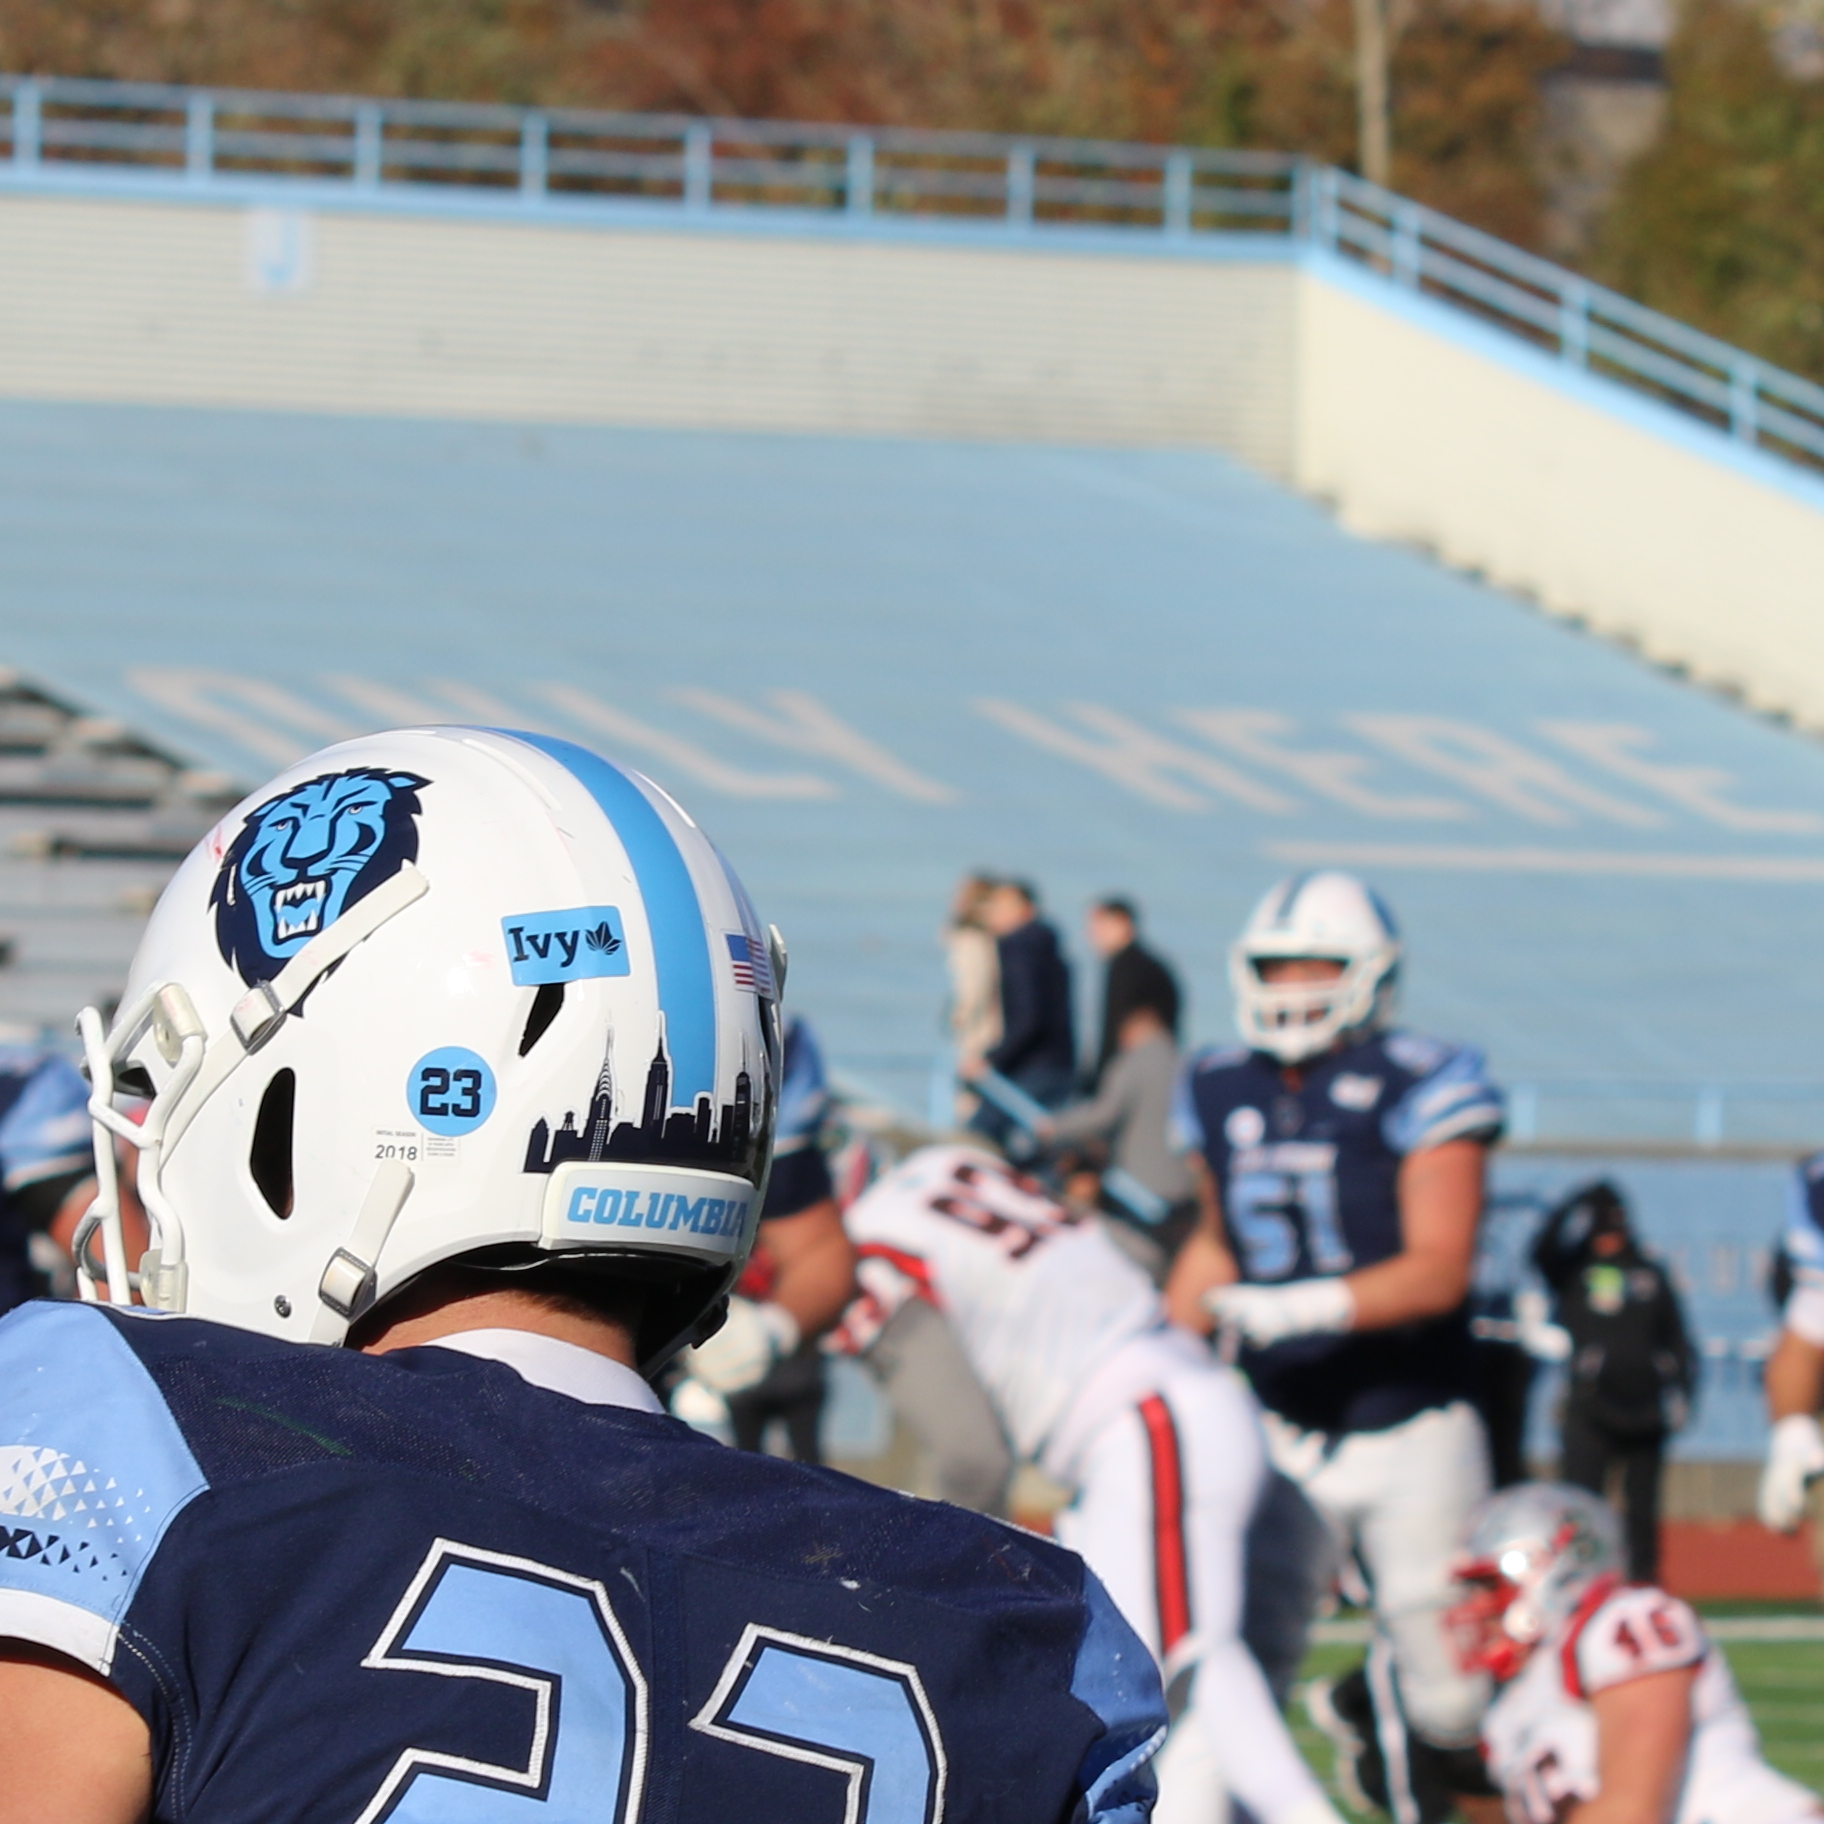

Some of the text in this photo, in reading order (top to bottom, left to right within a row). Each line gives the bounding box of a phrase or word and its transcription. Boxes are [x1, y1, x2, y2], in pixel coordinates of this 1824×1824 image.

[508, 927, 580, 967] Ivy
[419, 1067, 482, 1118] 23
[375, 1144, 418, 1161] 2018
[567, 1186, 749, 1240] COLUMBIA
[1228, 1170, 1354, 1280] 51
